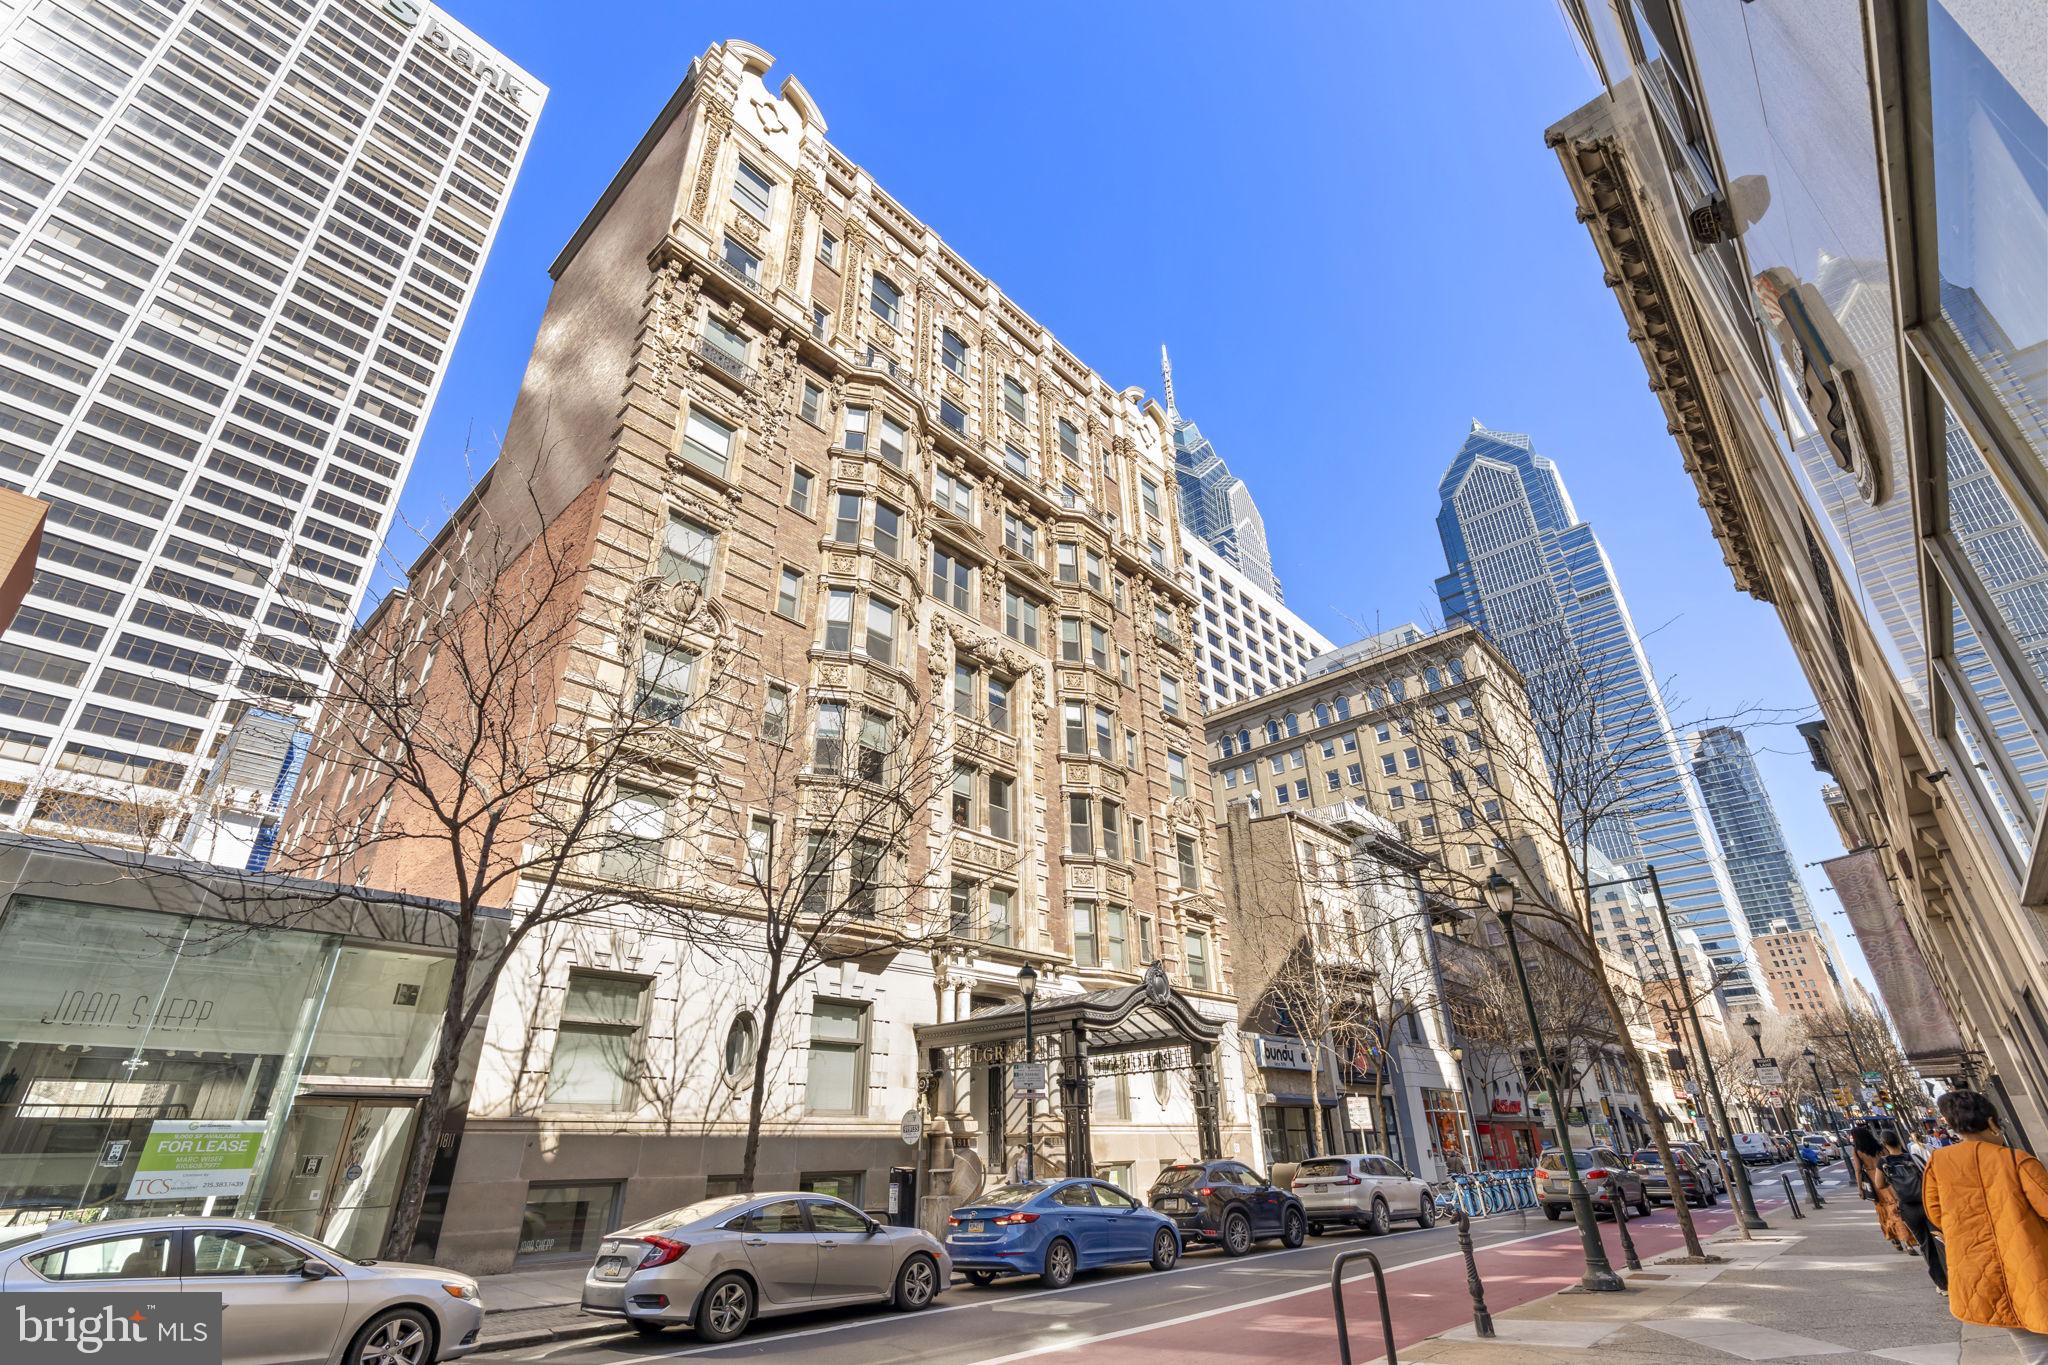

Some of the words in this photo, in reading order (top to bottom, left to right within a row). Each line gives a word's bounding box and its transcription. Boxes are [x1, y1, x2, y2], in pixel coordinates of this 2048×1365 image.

[423, 17, 523, 105] bank
[41, 990, 121, 1025] JOAN
[128, 995, 214, 1029] SHEPP
[157, 1140, 194, 1153] FOR
[196, 1139, 250, 1152] LEASE
[439, 1132, 456, 1148] 1811
[135, 1178, 173, 1196] TCS
